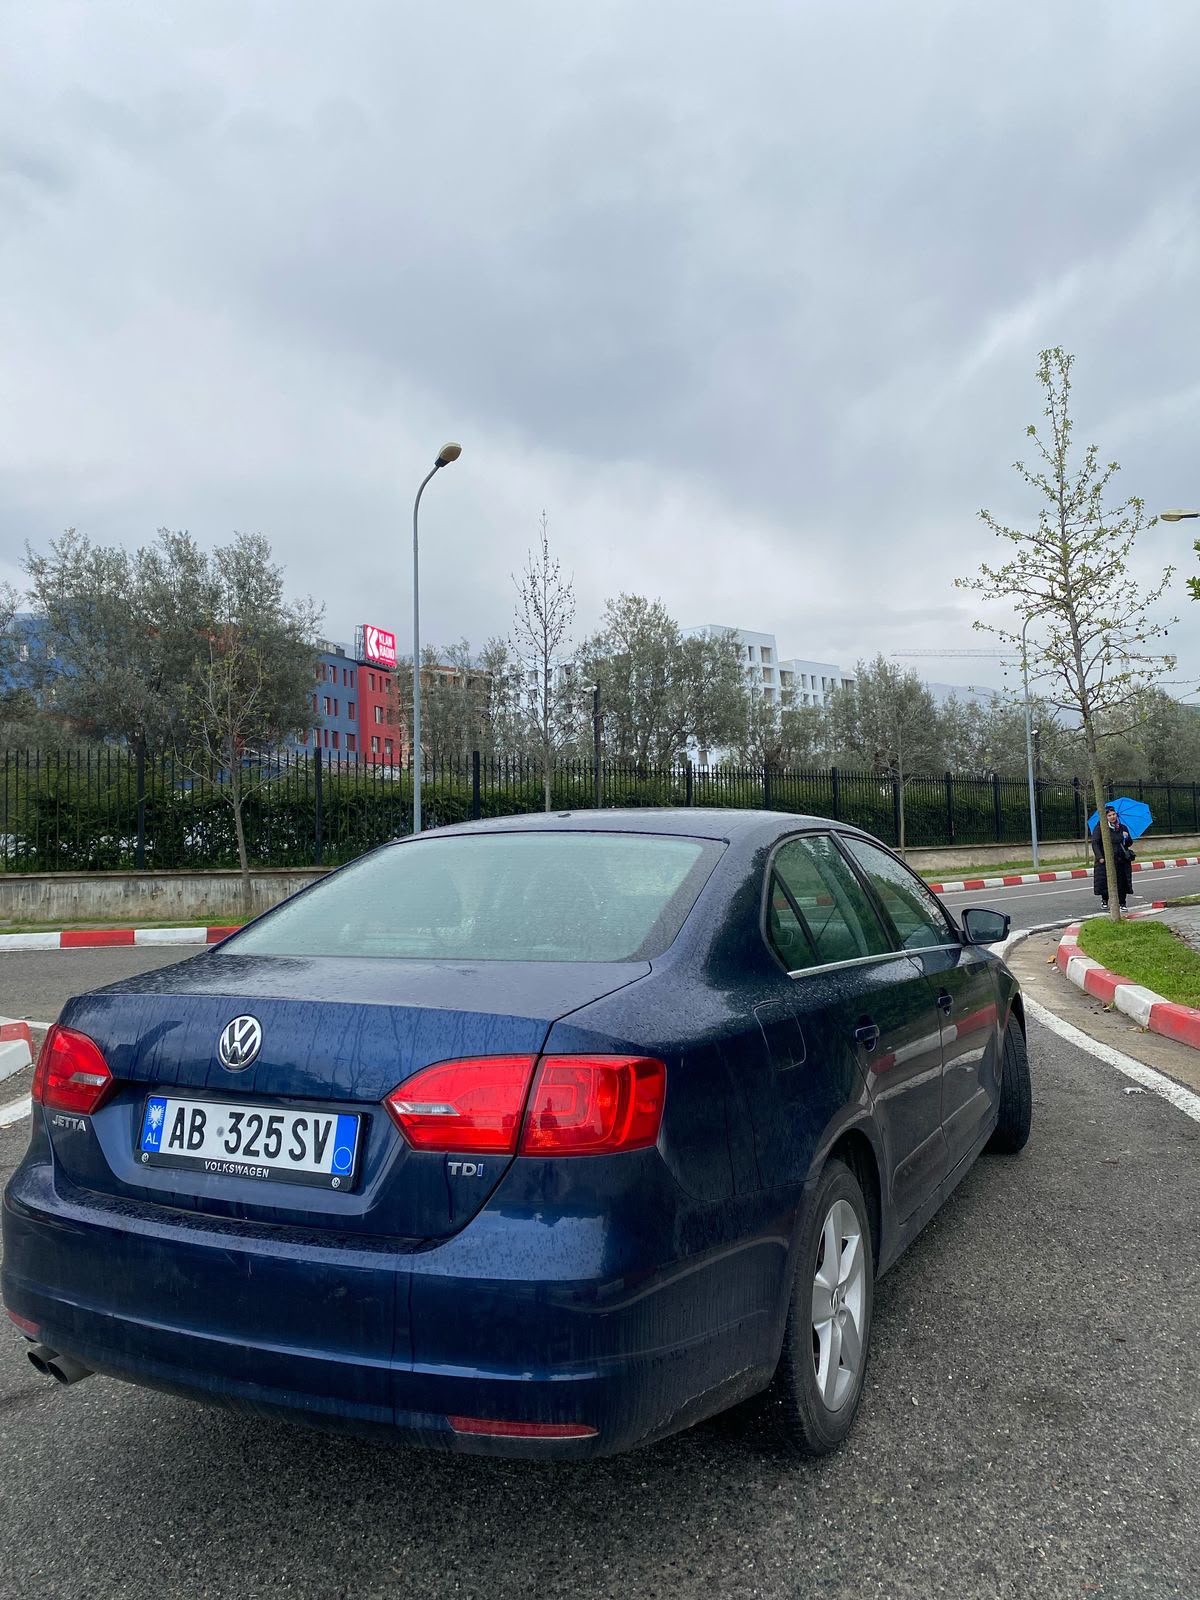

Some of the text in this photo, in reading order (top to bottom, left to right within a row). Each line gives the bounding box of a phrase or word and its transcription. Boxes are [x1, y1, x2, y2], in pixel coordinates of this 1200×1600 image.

[52, 1114, 87, 1132] JETTA
[168, 1107, 207, 1151] AB
[145, 1132, 159, 1145] AL
[204, 1161, 269, 1178] VOLKSWAGEN
[447, 1161, 484, 1177] TDI
